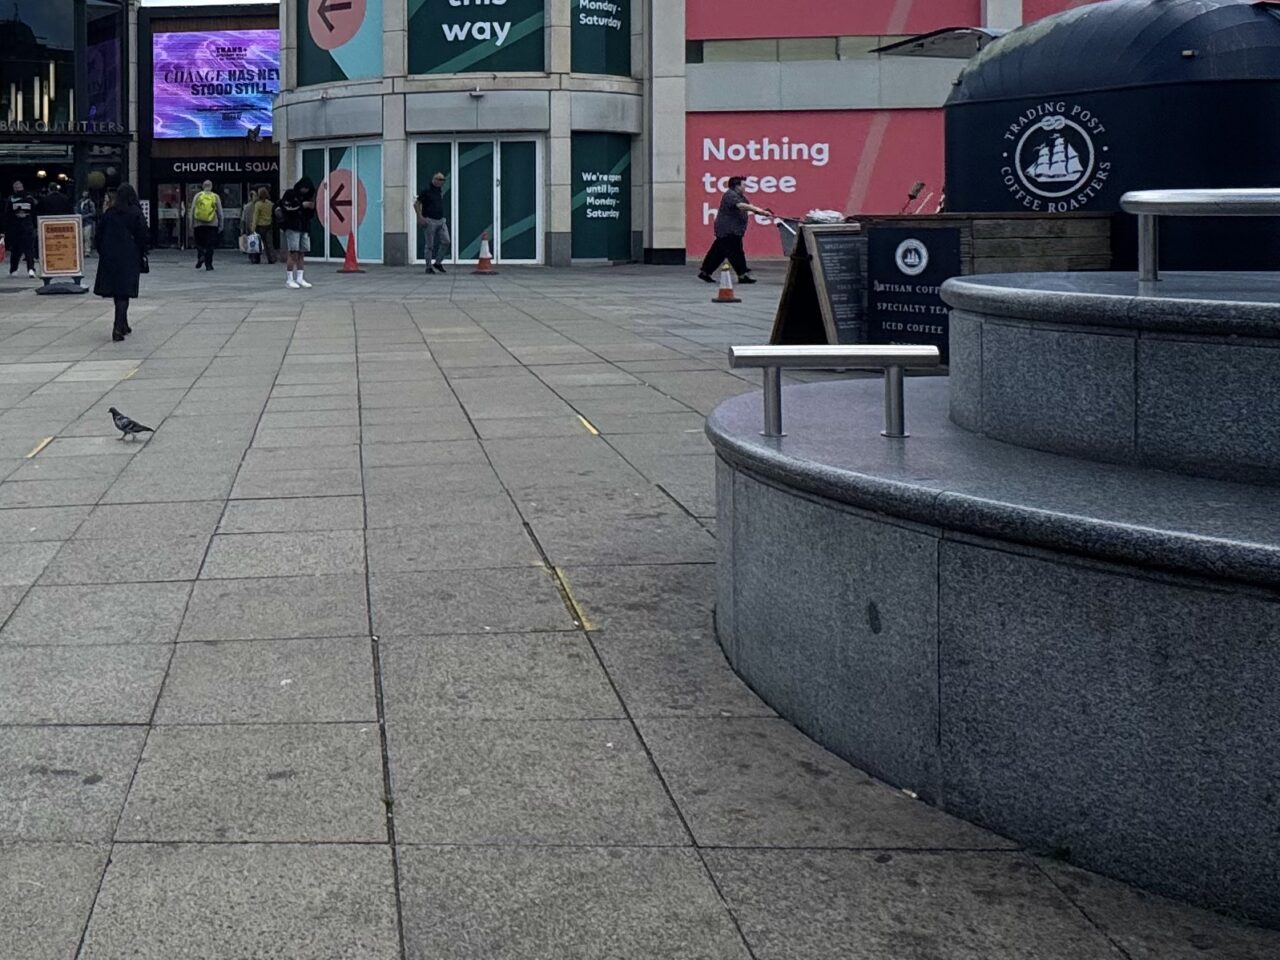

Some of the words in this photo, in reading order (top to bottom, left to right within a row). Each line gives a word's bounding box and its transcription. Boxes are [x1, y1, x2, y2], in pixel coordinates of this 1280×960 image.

[579, 13, 621, 30] Saturday
[442, 21, 512, 46] way
[228, 66, 254, 82] HAS
[191, 83, 233, 96] STOOD
[1004, 102, 1066, 140] TRADING
[1070, 104, 1105, 135] POST
[703, 137, 829, 166] Nothing
[173, 162, 242, 172] CHURCHILL
[245, 162, 279, 172] SQUA
[744, 176, 797, 193] see
[1001, 166, 1042, 211] COFFEE
[1048, 161, 1111, 213] ROASTERS
[874, 280, 913, 293] ARTISAN
[916, 284, 940, 294] COFF
[877, 302, 927, 313] SPECIALTY
[930, 306, 948, 315] TEA
[882, 321, 904, 331] ICED
[907, 323, 944, 334] COFFEE
